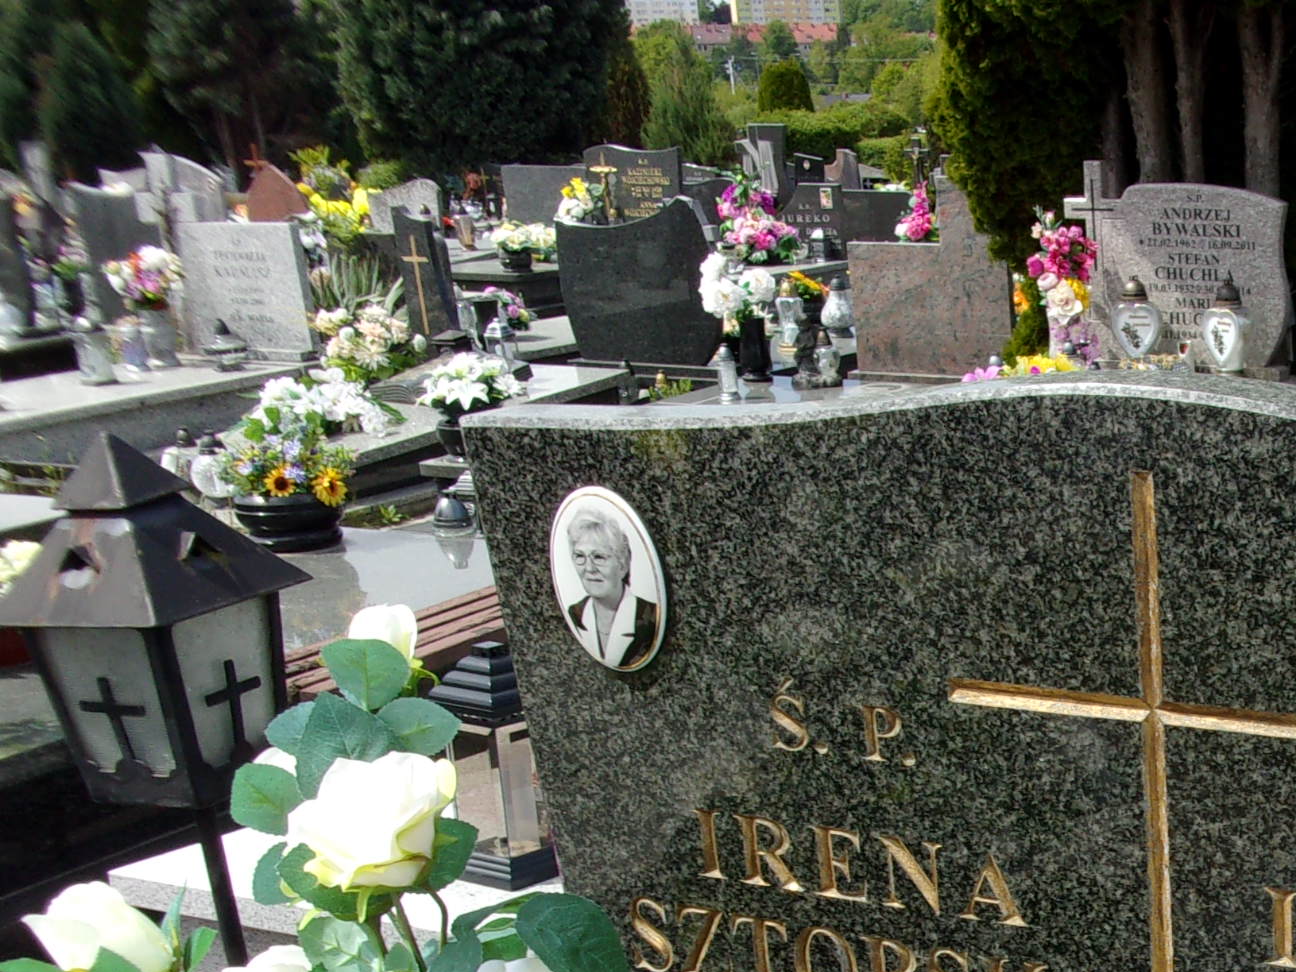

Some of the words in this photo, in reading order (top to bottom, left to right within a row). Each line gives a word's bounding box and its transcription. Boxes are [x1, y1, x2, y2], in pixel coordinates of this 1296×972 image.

[1161, 207, 1231, 221] ANDRZEJ
[1152, 222, 1241, 238] BYWALSKI
[1168, 253, 1220, 265] STEFAN
[1174, 297, 1211, 309] MARI
[862, 704, 916, 767] P.
[694, 807, 1029, 928] IRENA
